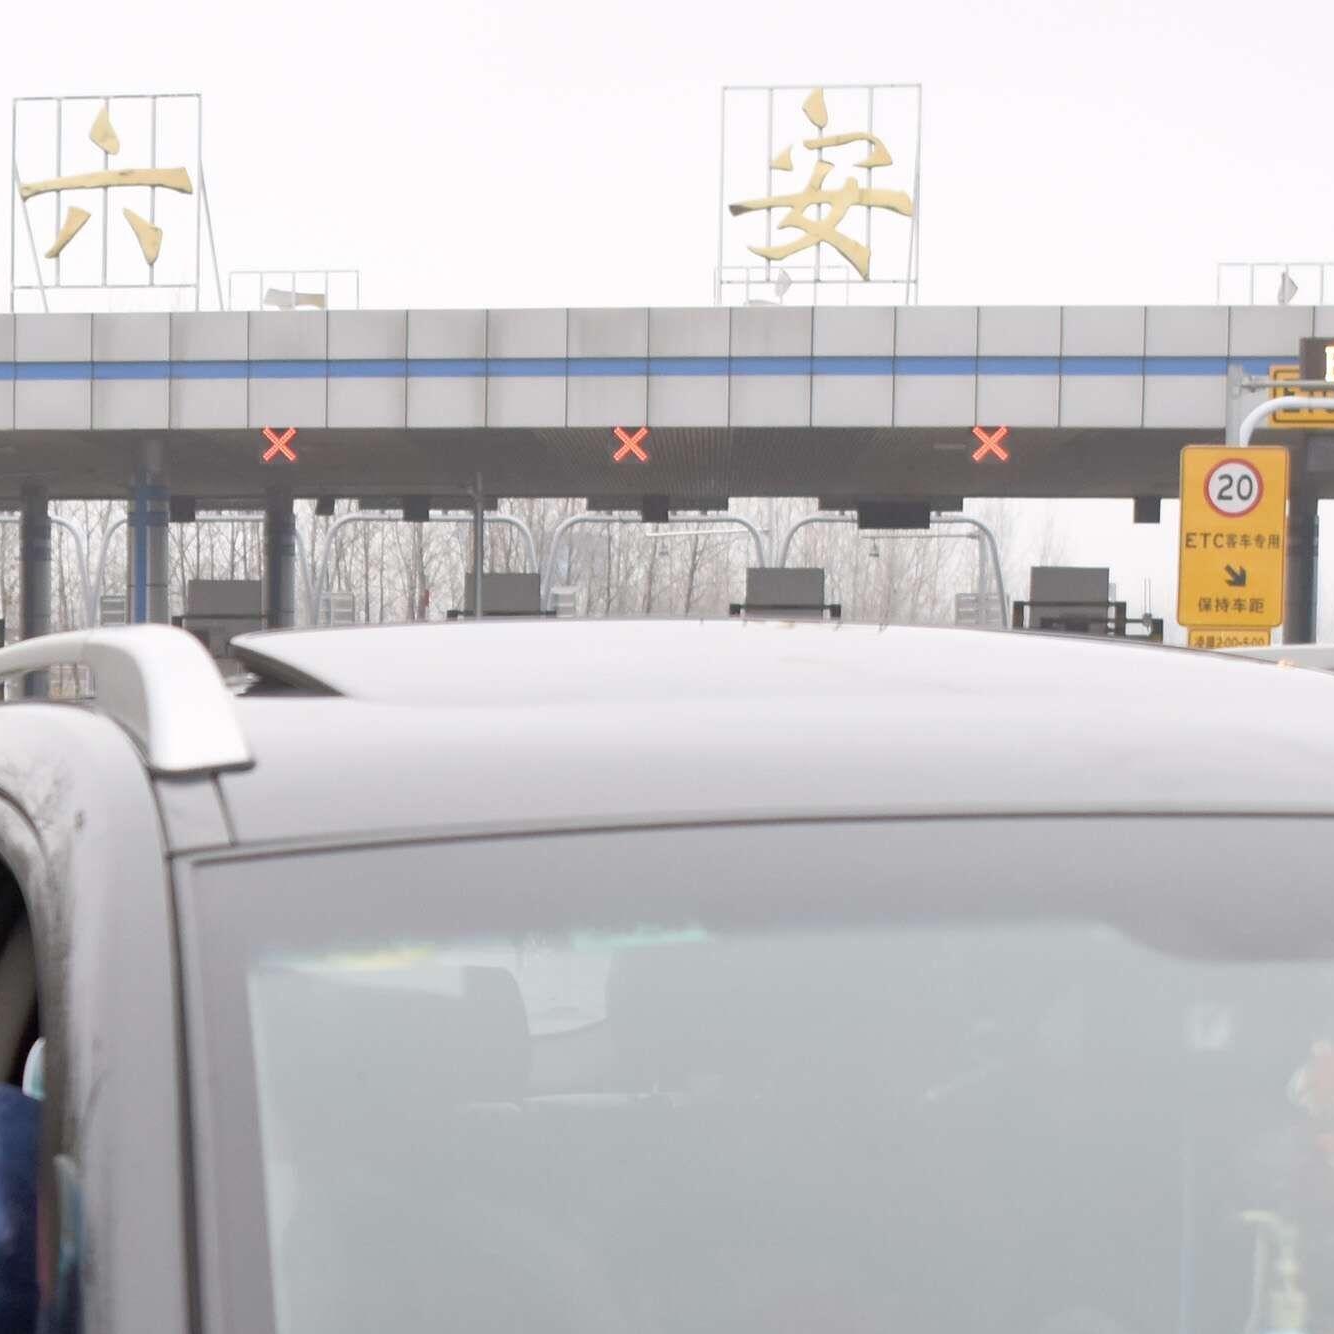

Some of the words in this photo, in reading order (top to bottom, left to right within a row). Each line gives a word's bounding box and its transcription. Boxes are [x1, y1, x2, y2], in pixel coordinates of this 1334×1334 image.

[1217, 474, 1253, 501] 20
[1185, 533, 1281, 549] ETC客车专用
[1198, 598, 1265, 613] 保持车距
